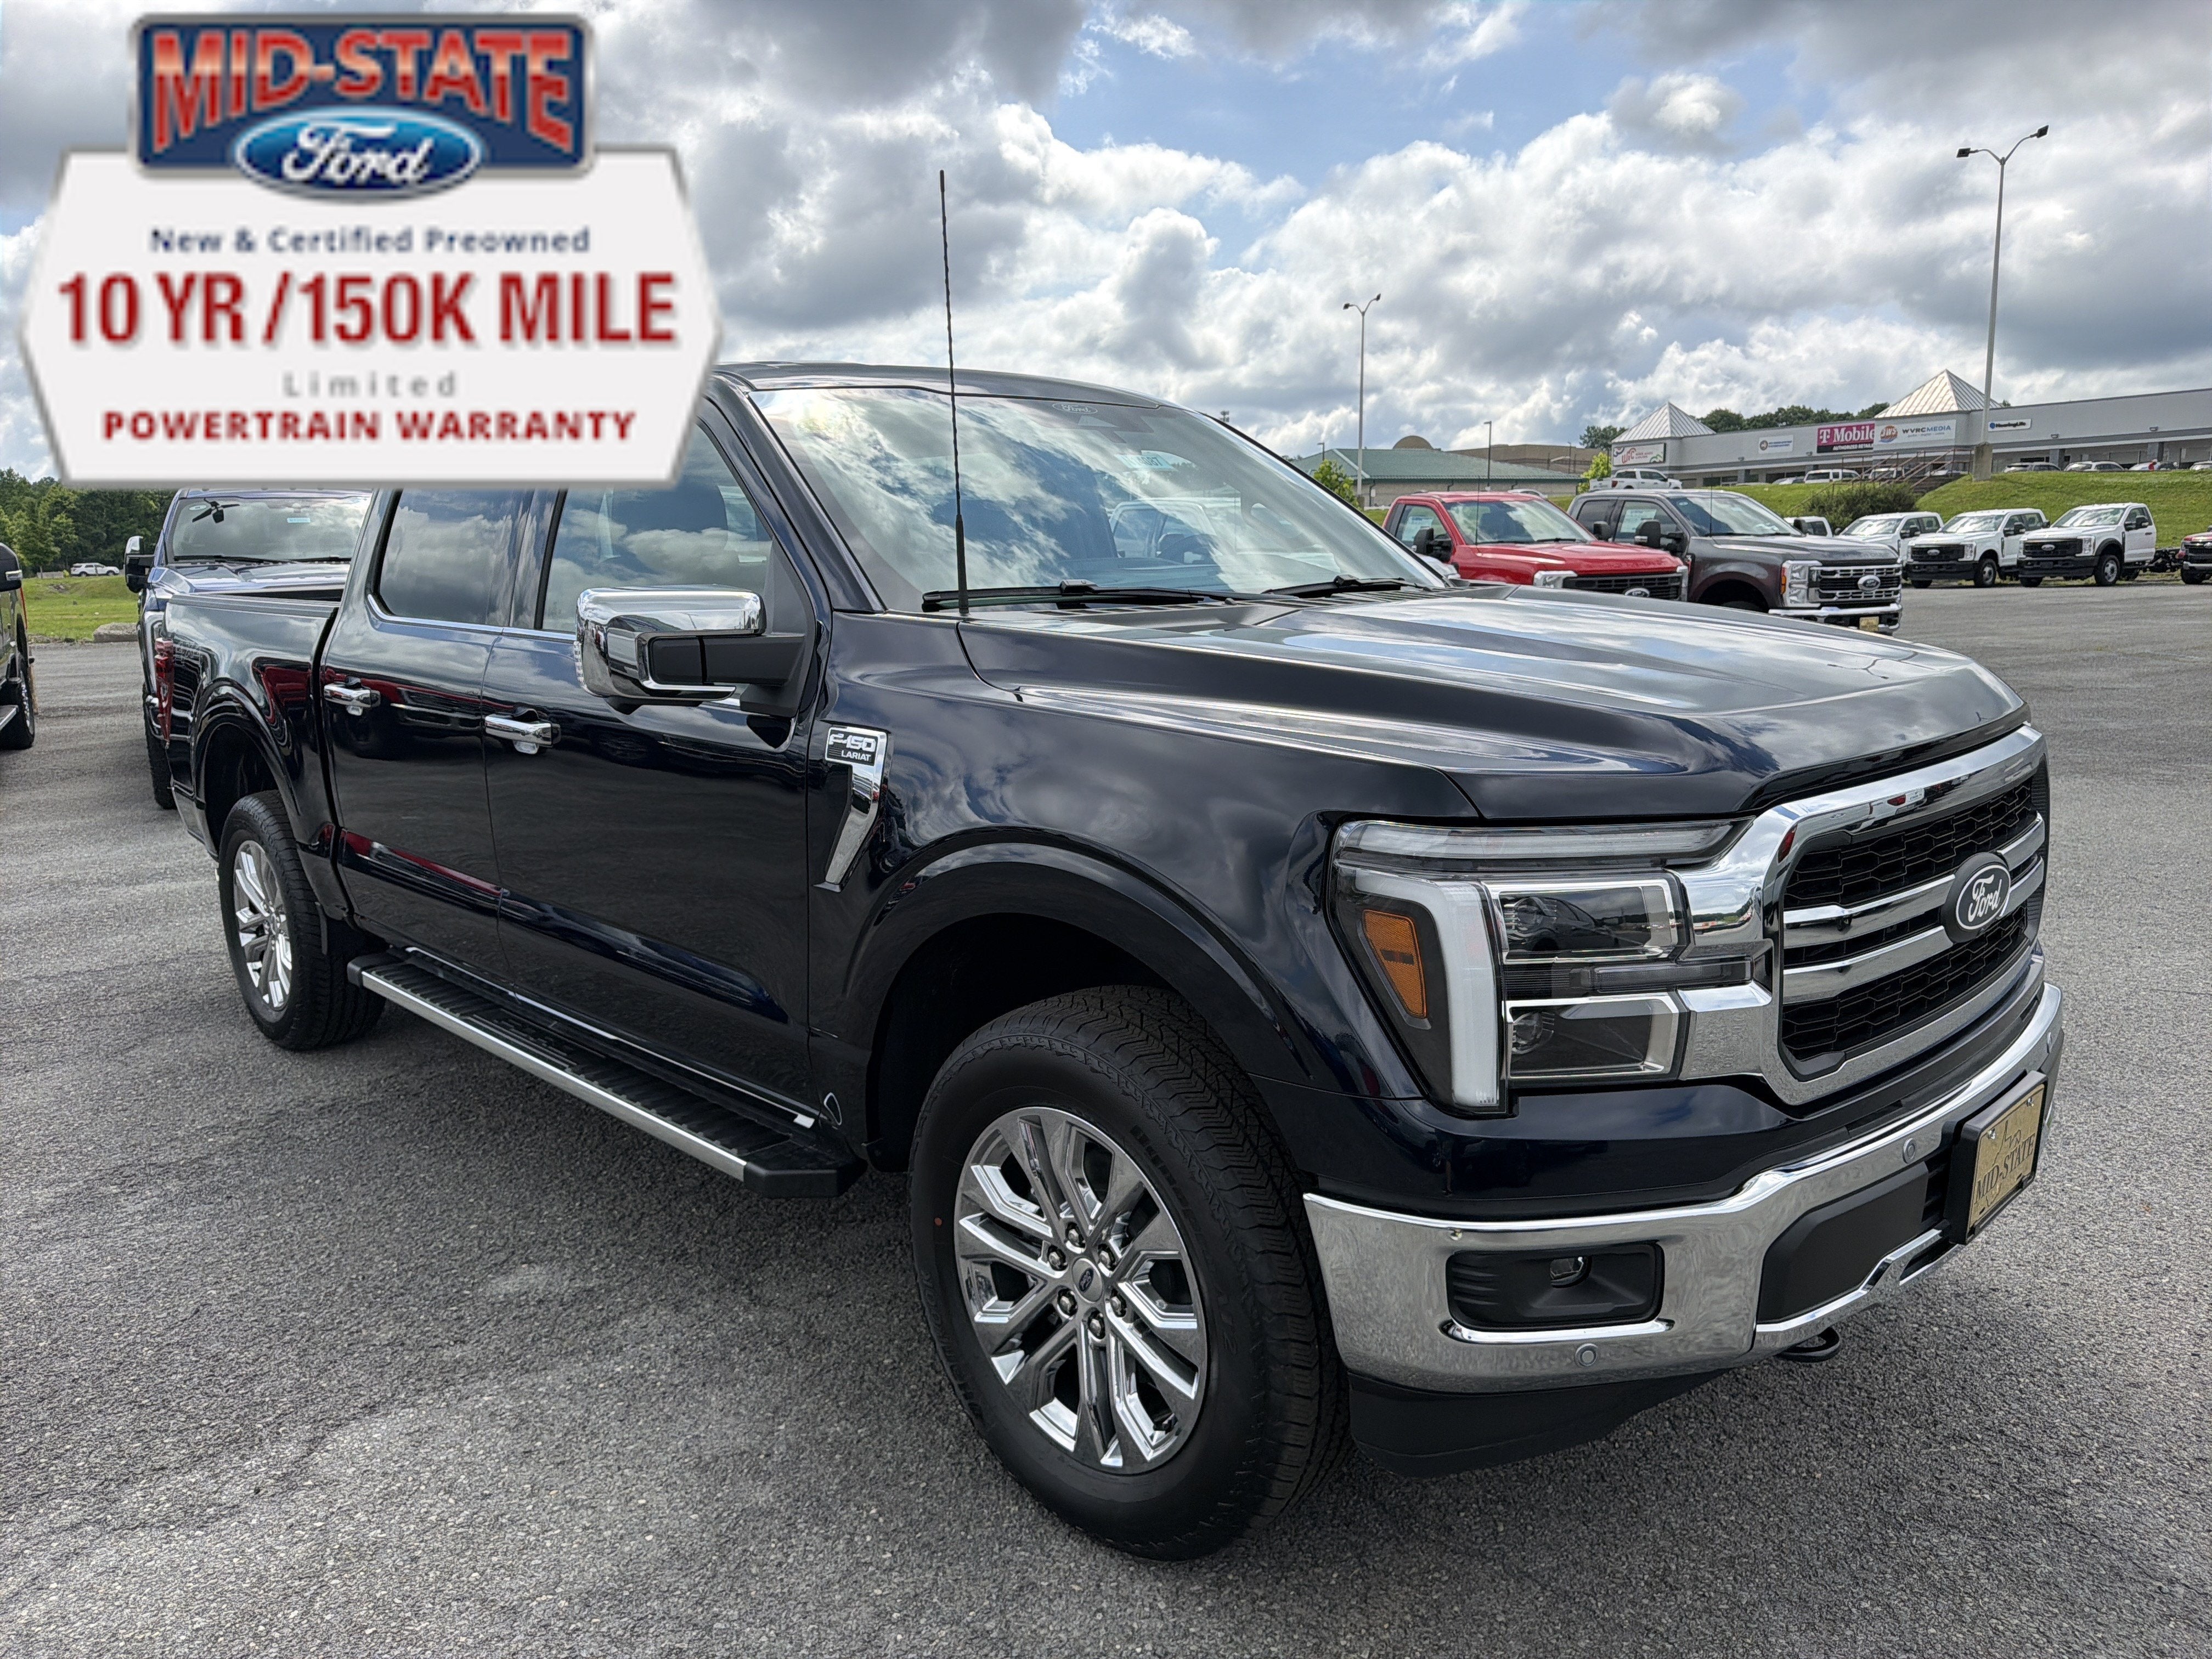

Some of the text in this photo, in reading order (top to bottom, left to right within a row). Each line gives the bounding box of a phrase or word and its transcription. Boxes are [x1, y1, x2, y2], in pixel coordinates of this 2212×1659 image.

[1061, 404, 1091, 413] Ford
[829, 733, 876, 752] F-150
[841, 749, 871, 761] LARIAT
[1968, 874, 2002, 922] Ford
[1975, 1132, 2035, 1204] MID-STATE
